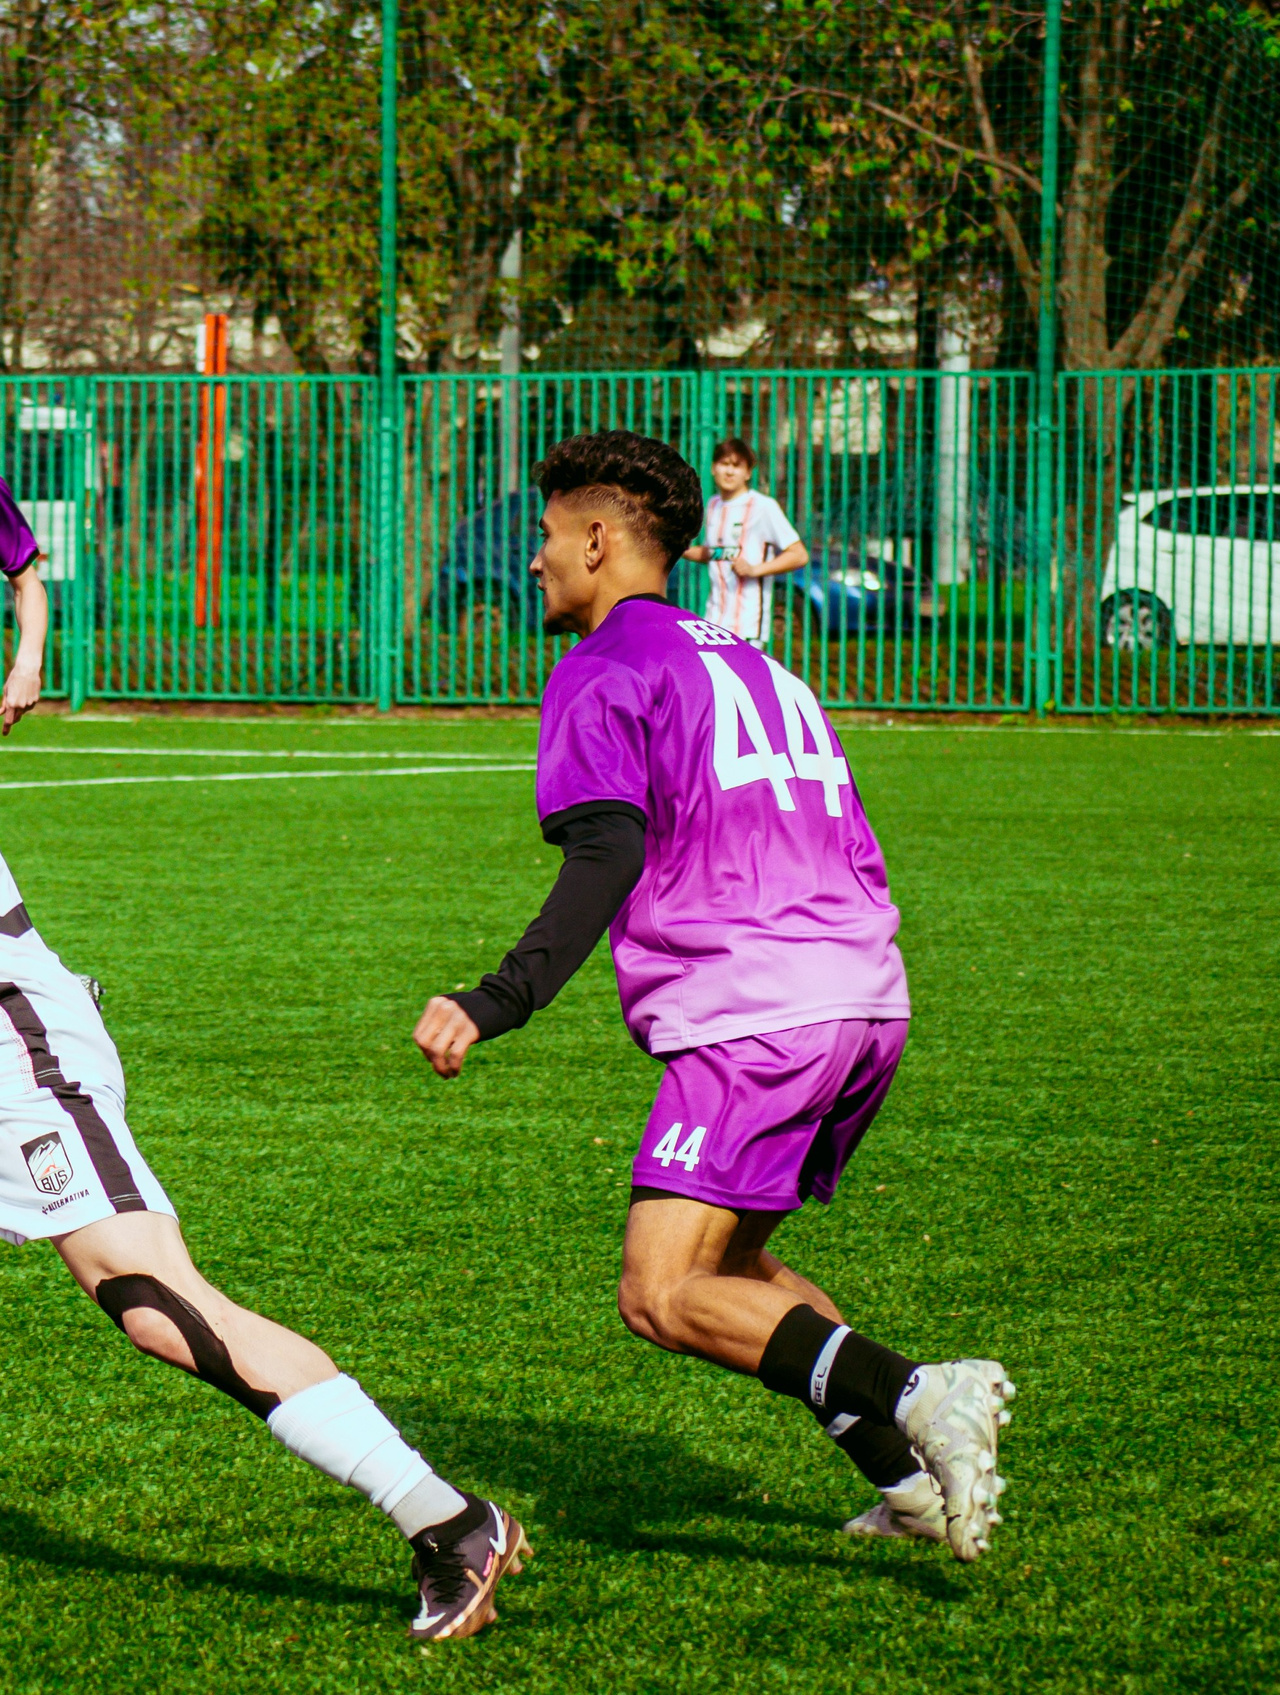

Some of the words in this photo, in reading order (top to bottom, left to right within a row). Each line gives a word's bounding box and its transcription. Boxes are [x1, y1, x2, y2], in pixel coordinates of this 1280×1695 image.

[697, 651, 850, 818] 44
[651, 1122, 707, 1172] 44
[41, 1169, 68, 1192] BUS
